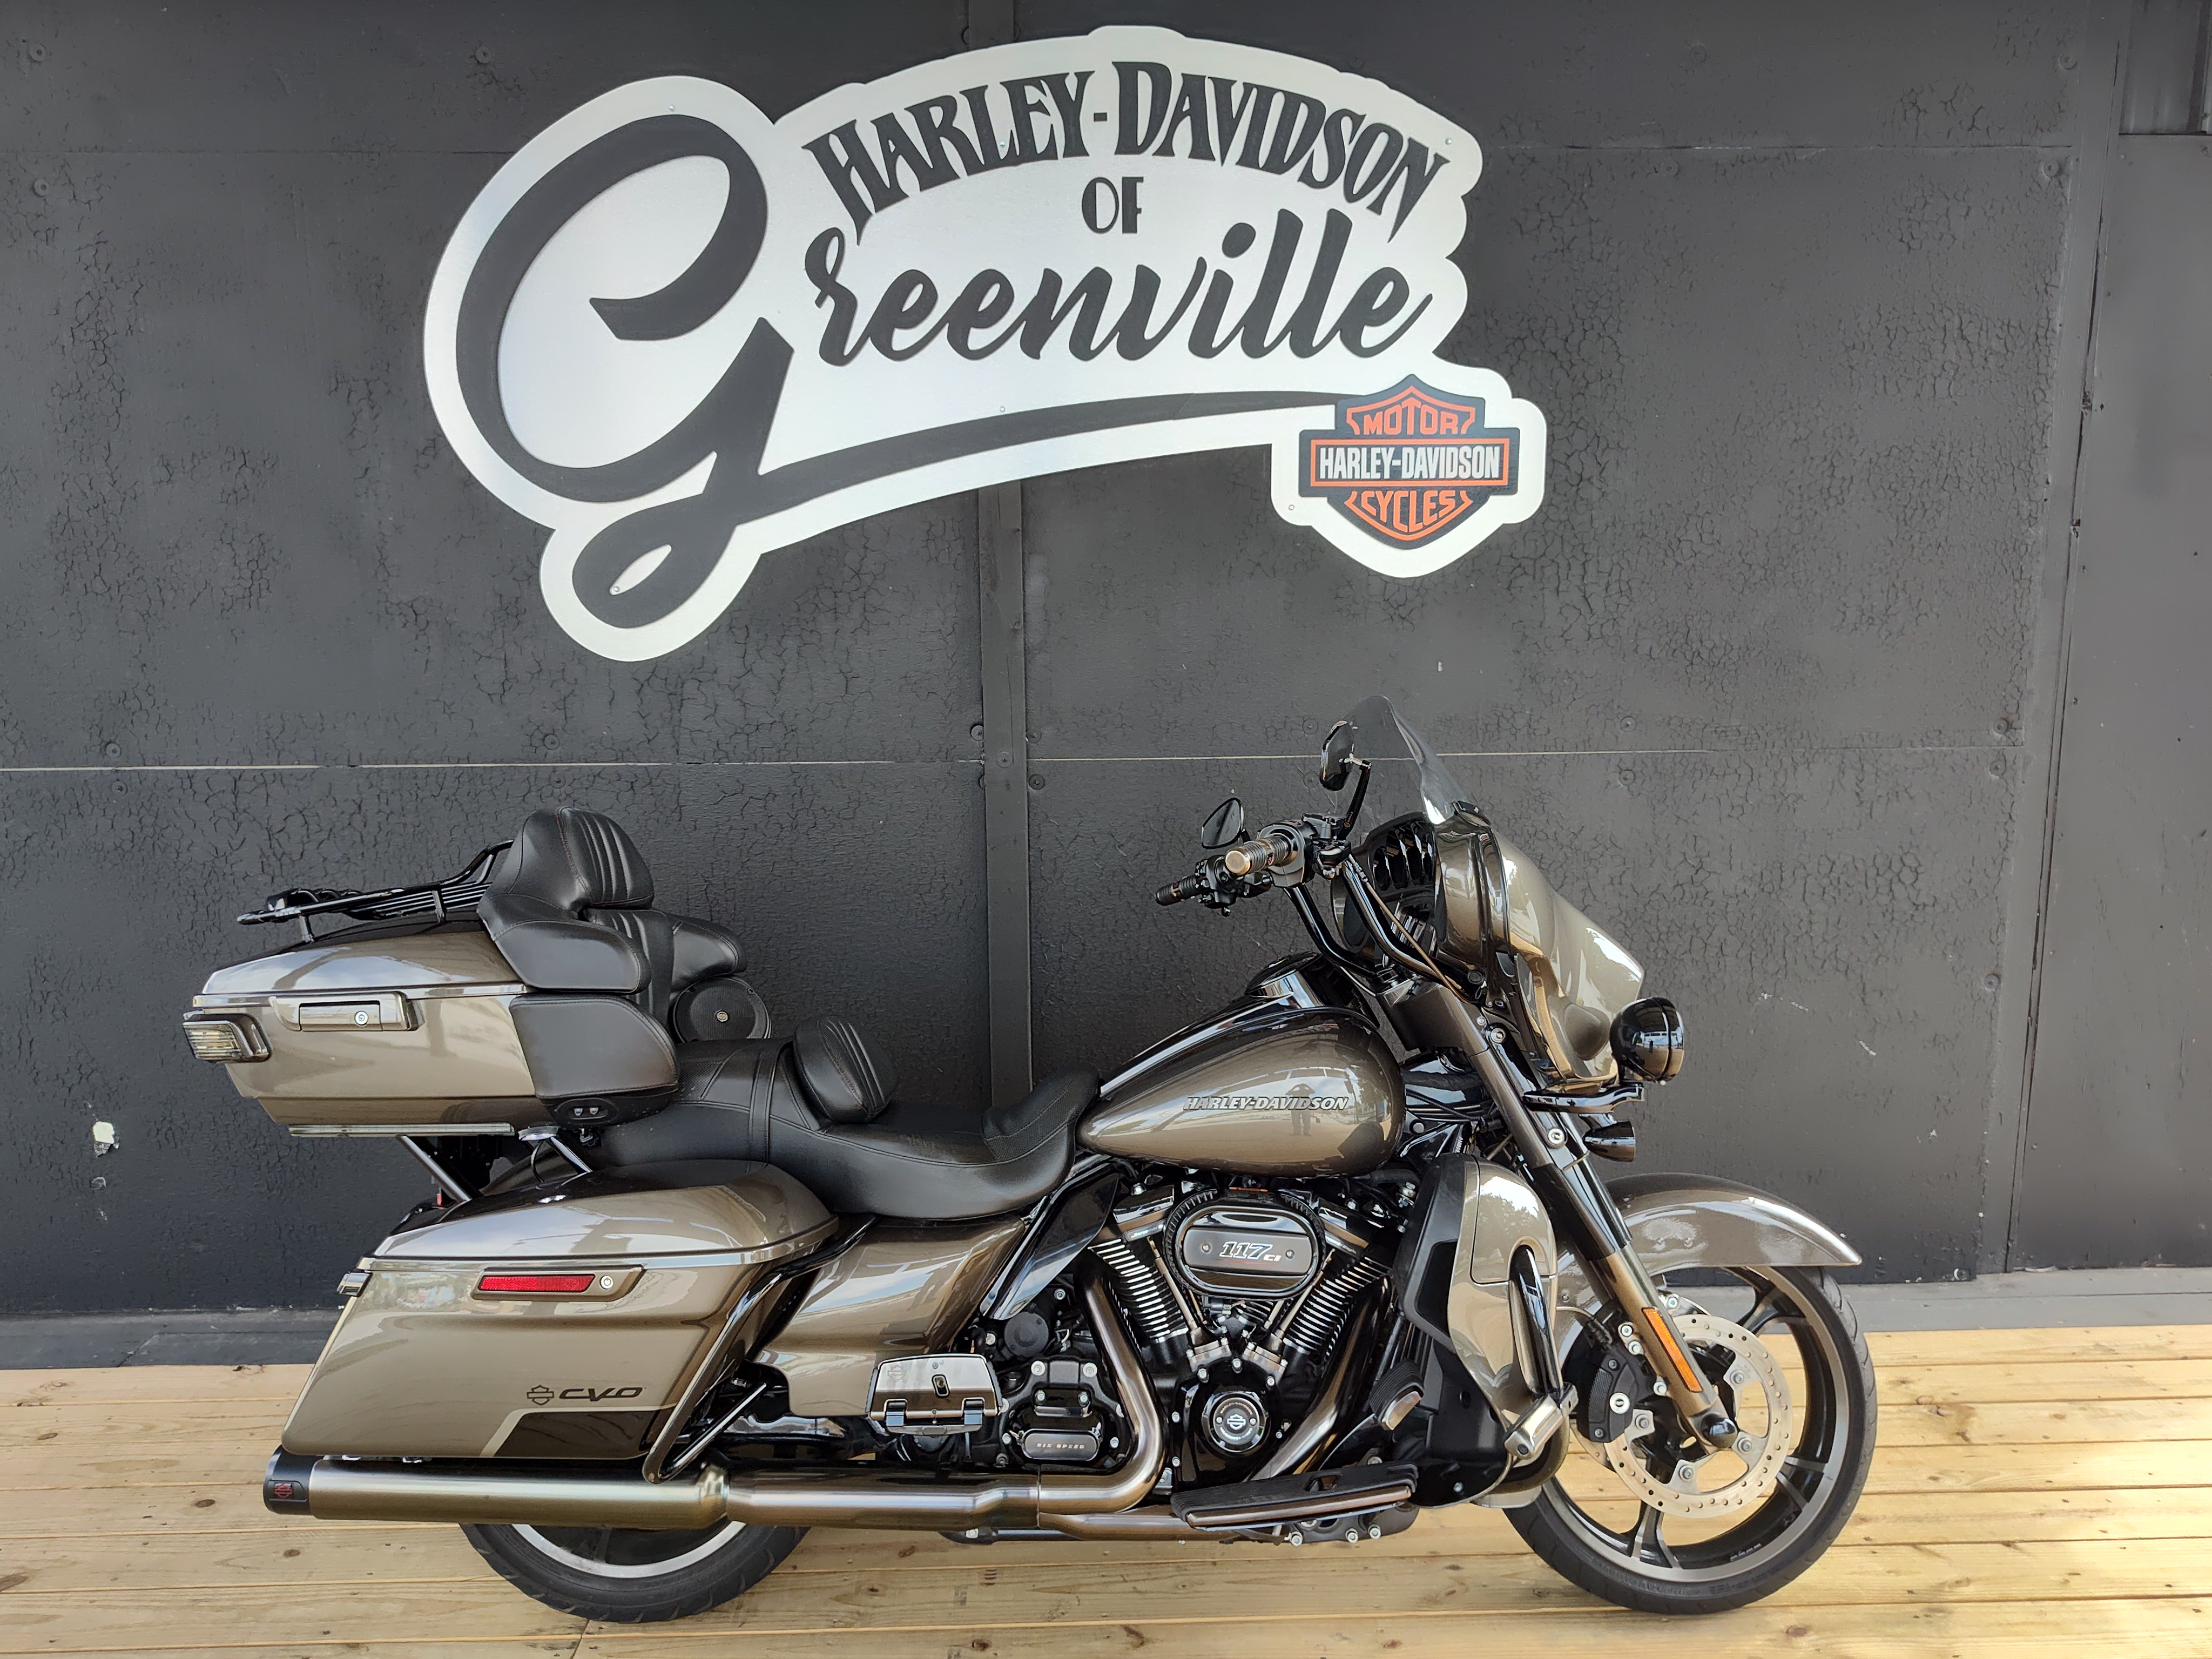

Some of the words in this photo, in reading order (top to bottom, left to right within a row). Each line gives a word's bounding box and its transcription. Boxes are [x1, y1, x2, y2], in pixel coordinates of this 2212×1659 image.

[801, 62, 1451, 246] HARLEY-DAVIDSON
[1081, 176, 1144, 234] OF
[456, 114, 1433, 629] Greenville
[1363, 396, 1458, 435] MOTOR
[1319, 445, 1500, 479] HARLEY-DAVIDSON
[1360, 489, 1456, 533] CYCLES
[1183, 1096, 1349, 1111] HARLEY-DAVIDSON
[559, 1387, 643, 1402] CVO
